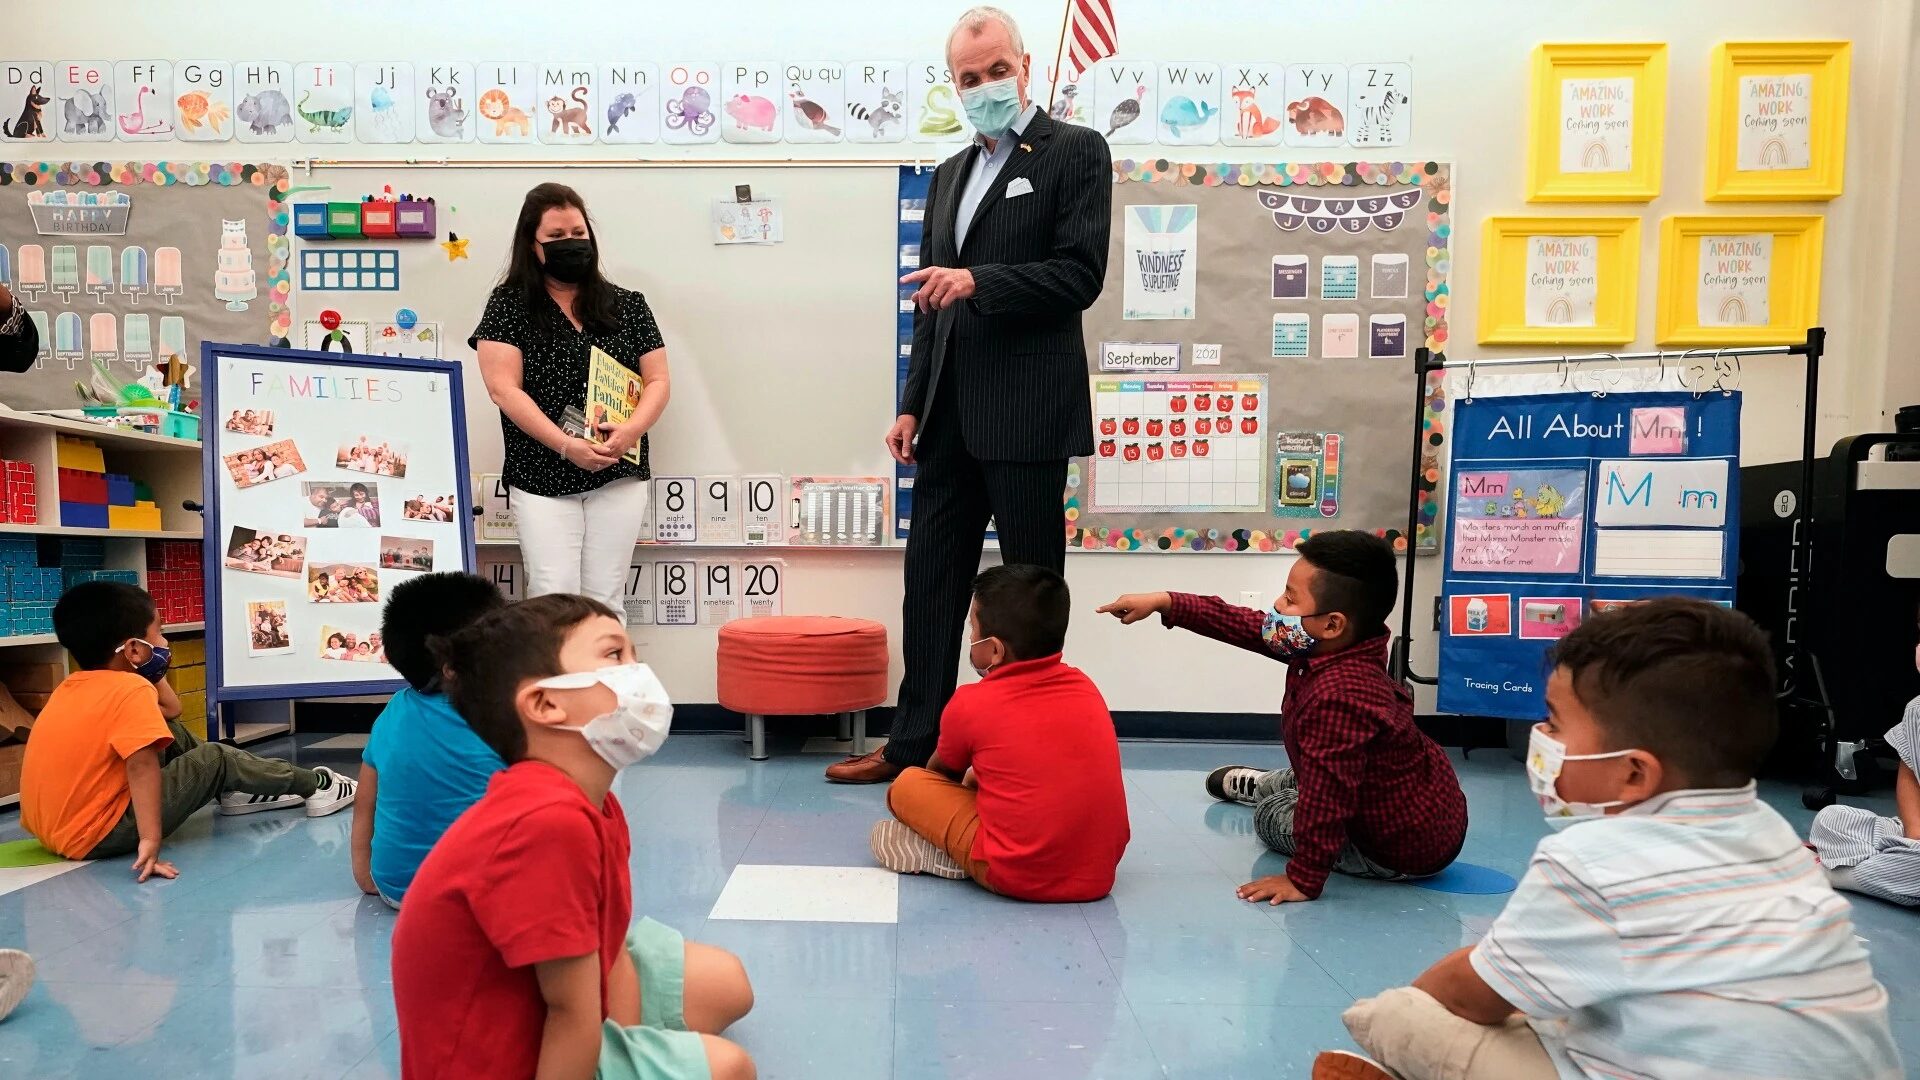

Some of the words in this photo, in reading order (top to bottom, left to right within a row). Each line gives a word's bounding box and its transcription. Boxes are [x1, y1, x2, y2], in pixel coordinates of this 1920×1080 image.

[1572, 85, 1624, 100] AMAZING
[1750, 82, 1803, 97] AMAZING
[1580, 104, 1615, 118] WORK
[1758, 101, 1793, 115] WORK
[1566, 117, 1600, 134] Coming
[1604, 120, 1628, 130] soon
[1744, 114, 1778, 132] Coming
[1783, 117, 1807, 127] soon
[1266, 194, 1411, 212] CLASS
[53, 209, 112, 221] HAPPY
[1283, 215, 1393, 231] JOBS
[53, 222, 112, 232] BIRTHDAY
[1538, 242, 1589, 257] AMAZING
[1710, 241, 1762, 256] AMAZING
[1137, 253, 1184, 273] KINDNESS
[1546, 260, 1580, 274] WORK
[1718, 259, 1752, 273] WORK
[1141, 273, 1148, 287] IS
[1149, 273, 1180, 289] UPLIFTING
[1531, 273, 1564, 290] Coming
[1569, 276, 1594, 286] soon
[1704, 272, 1738, 289] Coming
[1742, 276, 1766, 286] soon
[1107, 352, 1176, 368] September
[1196, 349, 1218, 359] 2021
[251, 372, 402, 402] FAMILIES
[1487, 414, 1532, 440] All
[1543, 413, 1624, 438] About
[1633, 414, 1681, 439] Mm
[1464, 476, 1503, 494] Mm
[1607, 471, 1653, 507] M
[495, 480, 510, 509] 4
[665, 481, 685, 512] 8
[708, 481, 728, 512] 9
[748, 480, 774, 512] 10
[495, 512, 511, 520] four
[666, 515, 685, 524] eight
[1463, 523, 1501, 531] Mosters
[1511, 534, 1545, 542] Monster
[1503, 557, 1514, 565] for
[664, 565, 687, 595] 18
[707, 565, 730, 595] 19
[744, 564, 779, 595] 20
[750, 599, 774, 607] twenty
[1464, 677, 1499, 694] Tracing
[1503, 681, 1533, 693] Cards
